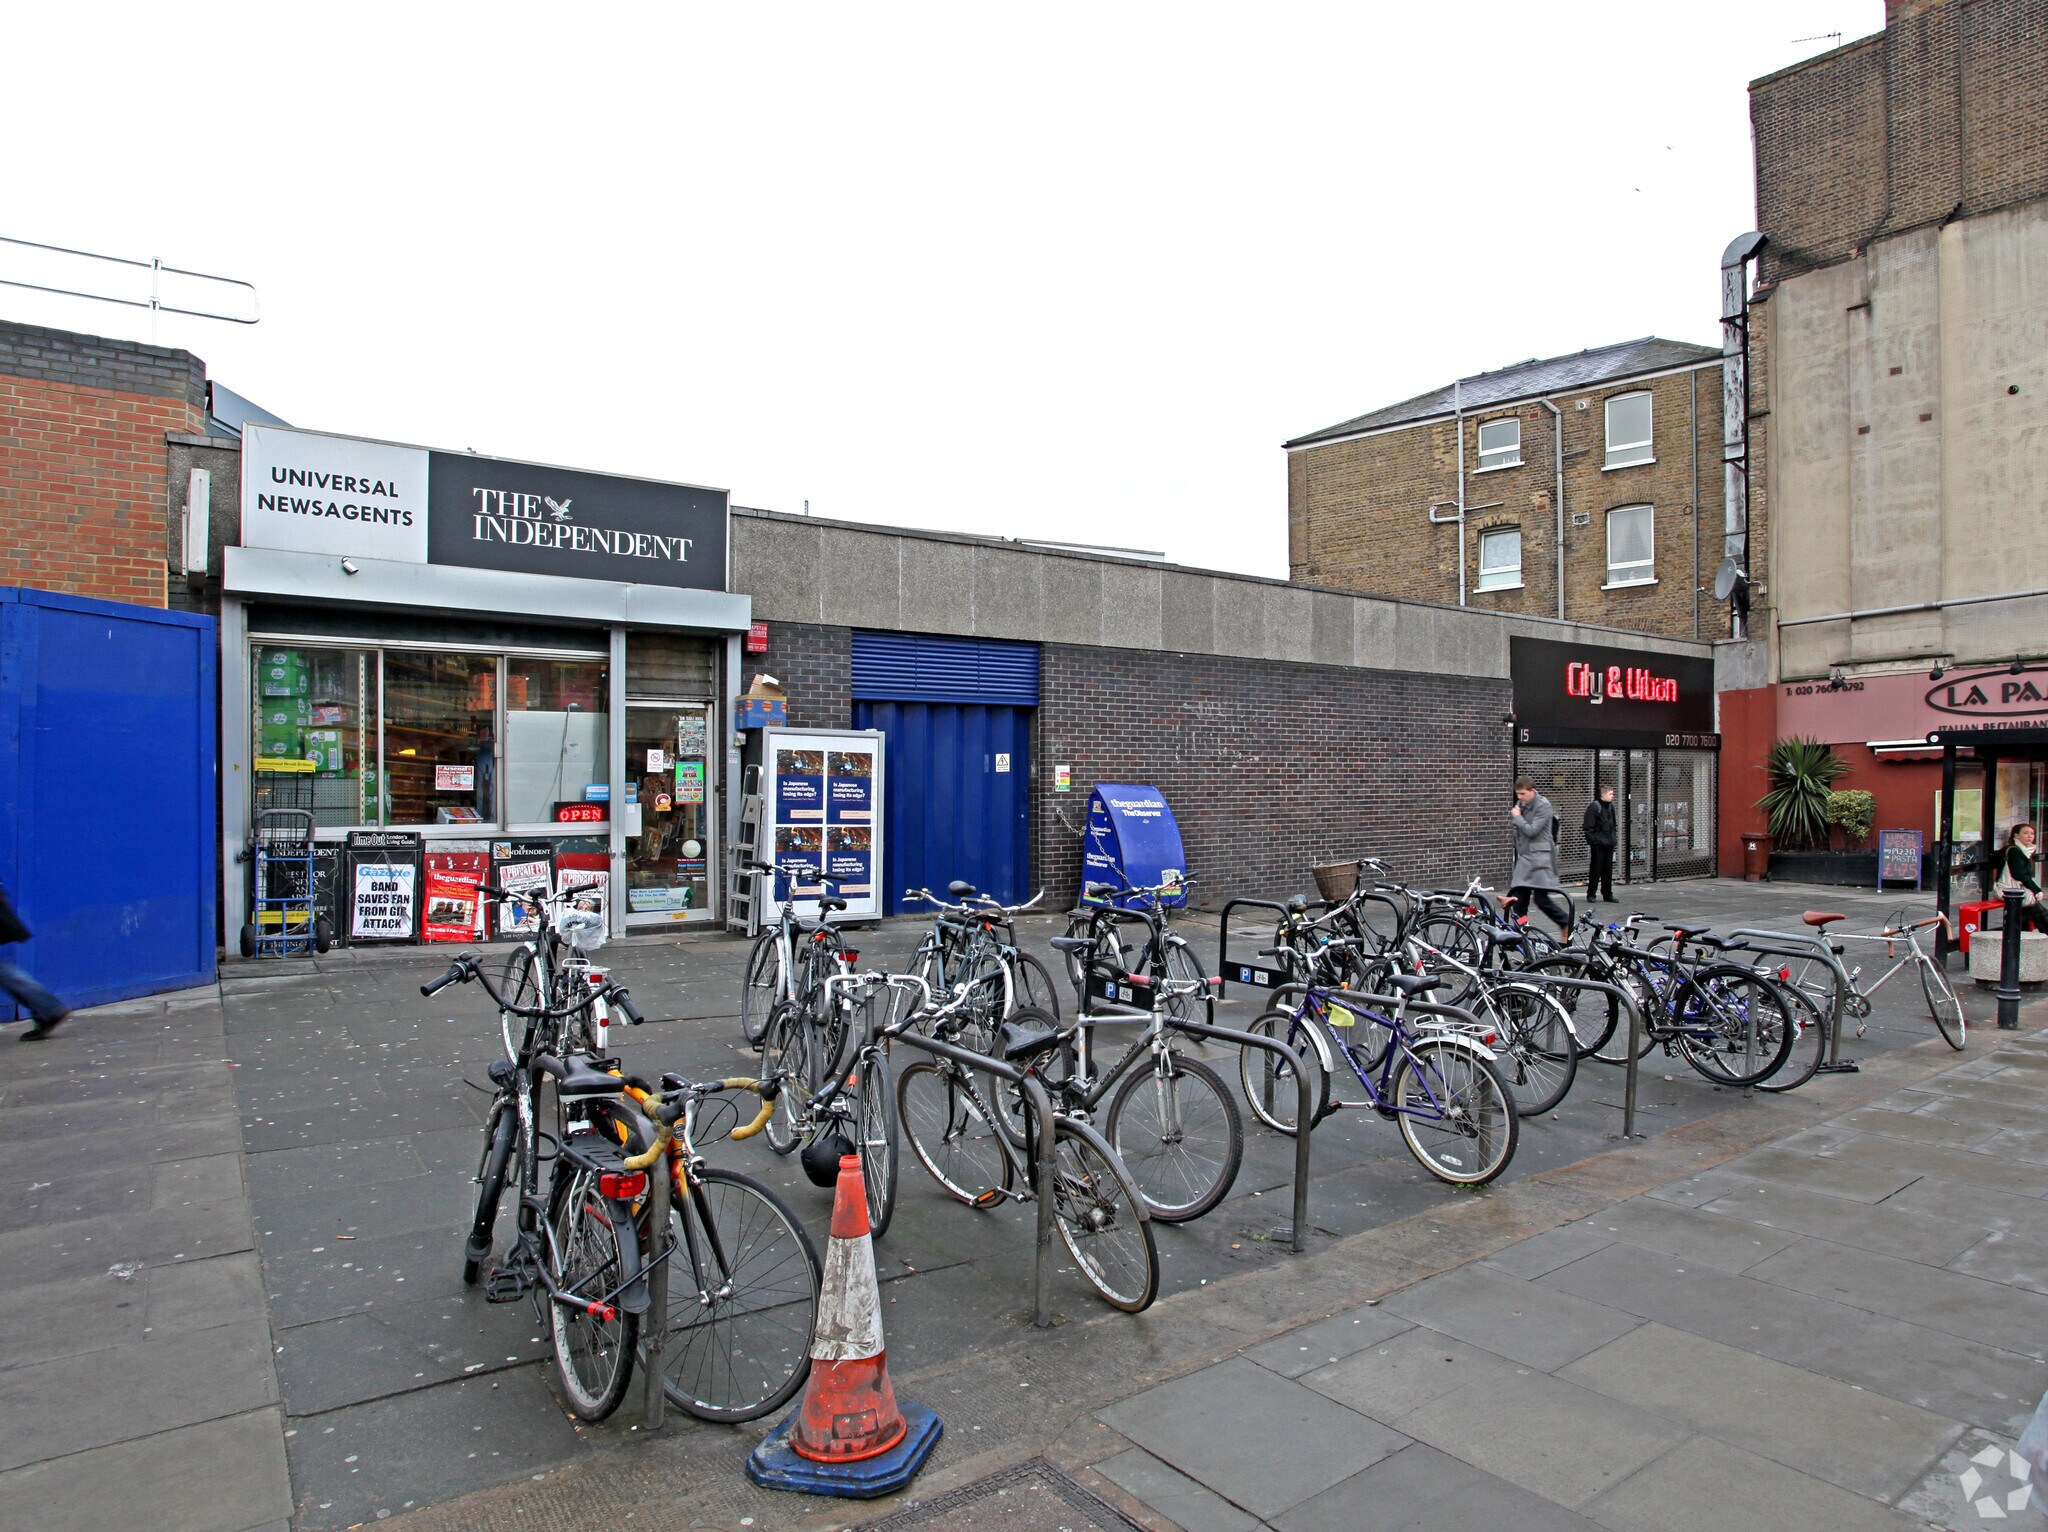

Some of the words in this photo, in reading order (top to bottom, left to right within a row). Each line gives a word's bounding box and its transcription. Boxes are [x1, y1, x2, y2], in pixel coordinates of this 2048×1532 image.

[272, 466, 399, 498] UNIVERSAL
[473, 487, 542, 520] THE
[257, 493, 413, 527] NEWSAGENTS
[472, 514, 693, 562] INDEPENDENT
[1566, 662, 1604, 705] City
[1606, 665, 1625, 699] &
[1626, 666, 1679, 702] Urban
[1795, 686, 1813, 696] 020
[1841, 681, 1865, 692] 6792
[1947, 684, 1989, 707] LA
[2002, 680, 2048, 704] PA
[1520, 728, 1530, 742] 15
[1665, 734, 1680, 747] 020
[1682, 735, 1698, 747] 7700
[1700, 735, 1717, 748] 7600
[1110, 799, 1164, 809] theguardian
[560, 808, 602, 821] OPEN
[1886, 833, 1915, 841] LUNCH
[1884, 839, 1919, 849] SPECIAL
[272, 848, 340, 857] INDEPEDENT
[510, 848, 551, 856] NDEPENDENT
[1891, 855, 1918, 863] PASTA
[358, 866, 411, 877] Gazette
[508, 864, 536, 878] PRIVATE
[536, 862, 548, 874] EYE
[433, 873, 478, 884] theguardian
[569, 873, 596, 884] PRIVATE
[371, 881, 399, 891] BAND
[358, 894, 389, 904] SAVES
[391, 894, 410, 904] FAN
[359, 906, 387, 916] FROM
[363, 919, 402, 929] ATTACK
[1242, 968, 1250, 981] P
[1107, 982, 1115, 996] P
